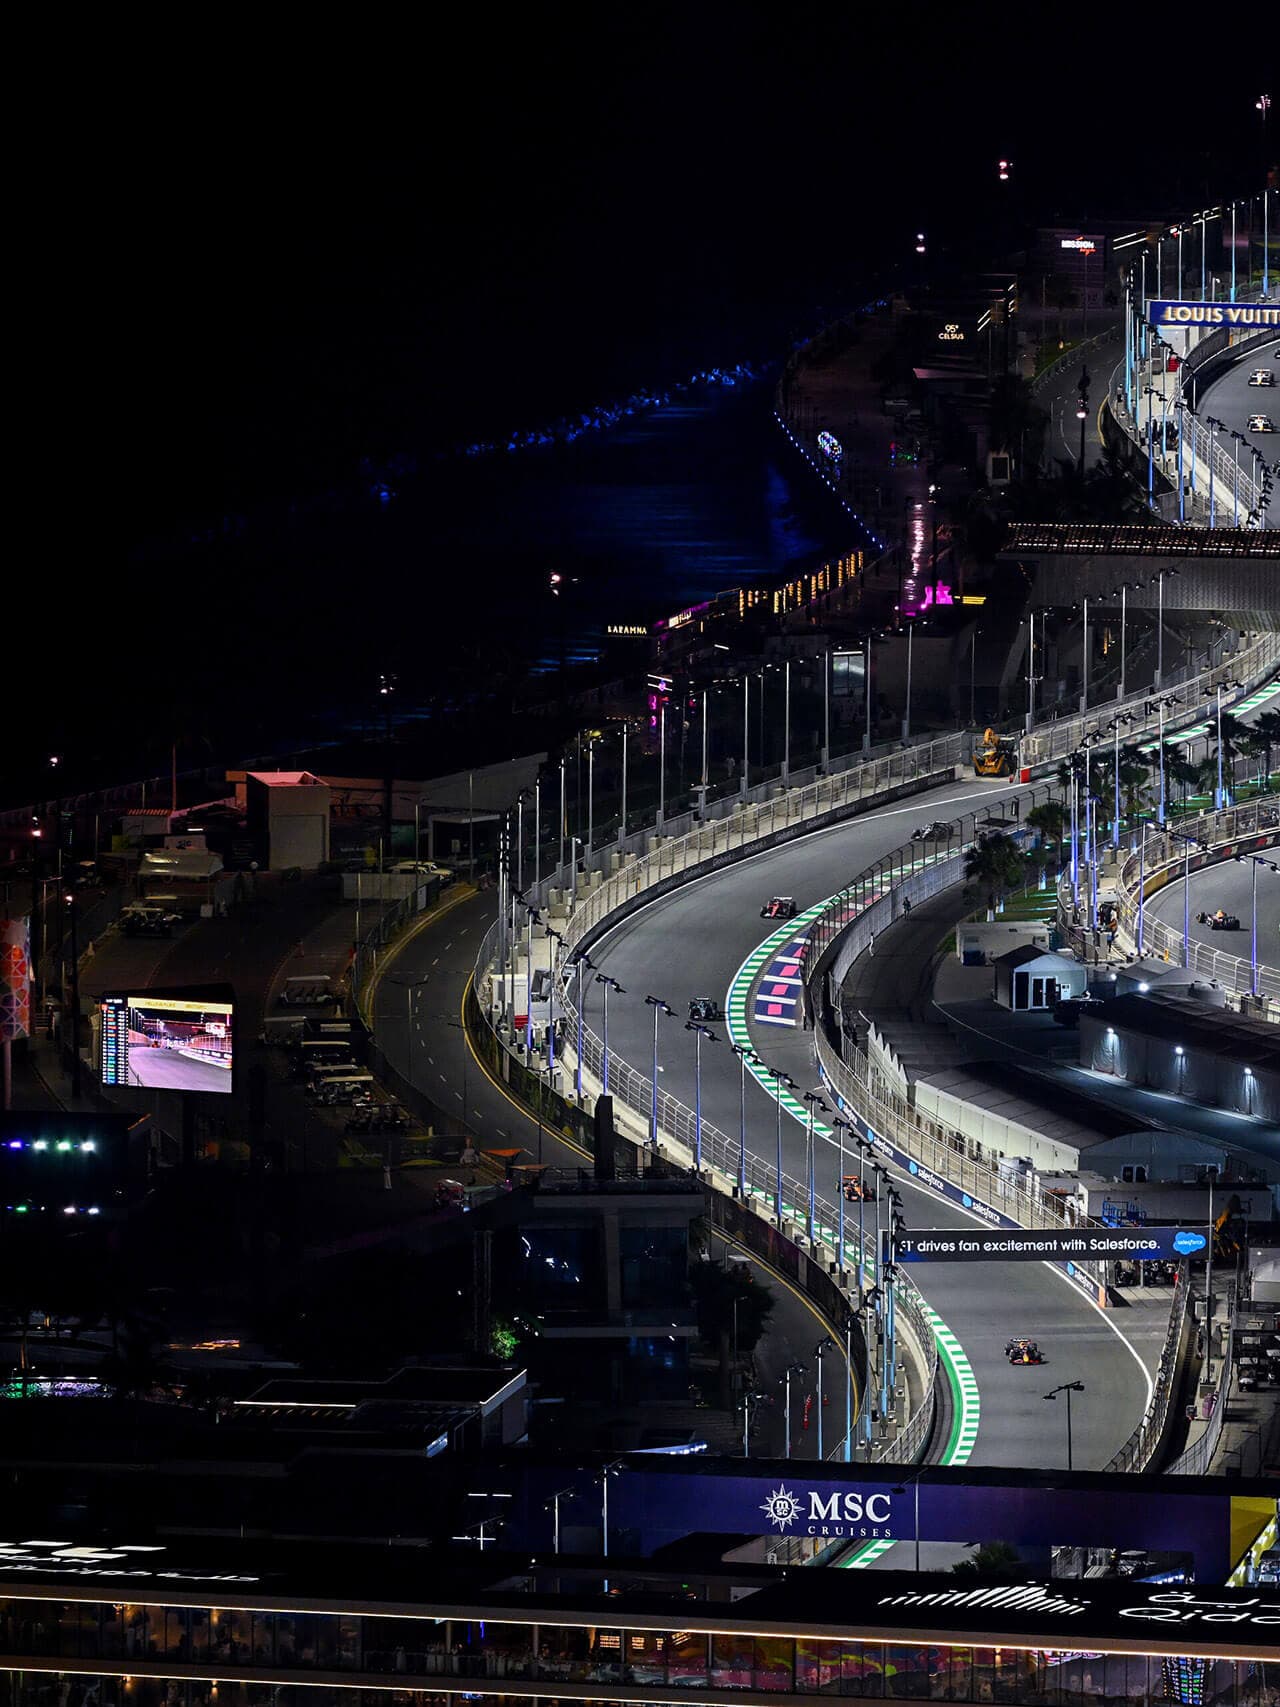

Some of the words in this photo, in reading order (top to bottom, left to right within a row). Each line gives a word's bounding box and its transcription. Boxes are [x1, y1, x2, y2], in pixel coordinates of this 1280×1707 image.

[1165, 306, 1224, 323] LOUIS
[917, 1169, 945, 1190] salesforce
[972, 1201, 1001, 1224] salesforce
[917, 1240, 955, 1252] drives
[959, 1240, 980, 1252] fan
[983, 1239, 1058, 1252] excitement
[1061, 1239, 1087, 1250] with
[1089, 1238, 1160, 1250] Salesforce.
[1177, 1239, 1203, 1247] salesforce
[808, 1492, 891, 1523] MSC
[808, 1526, 891, 1537] CRUISES
